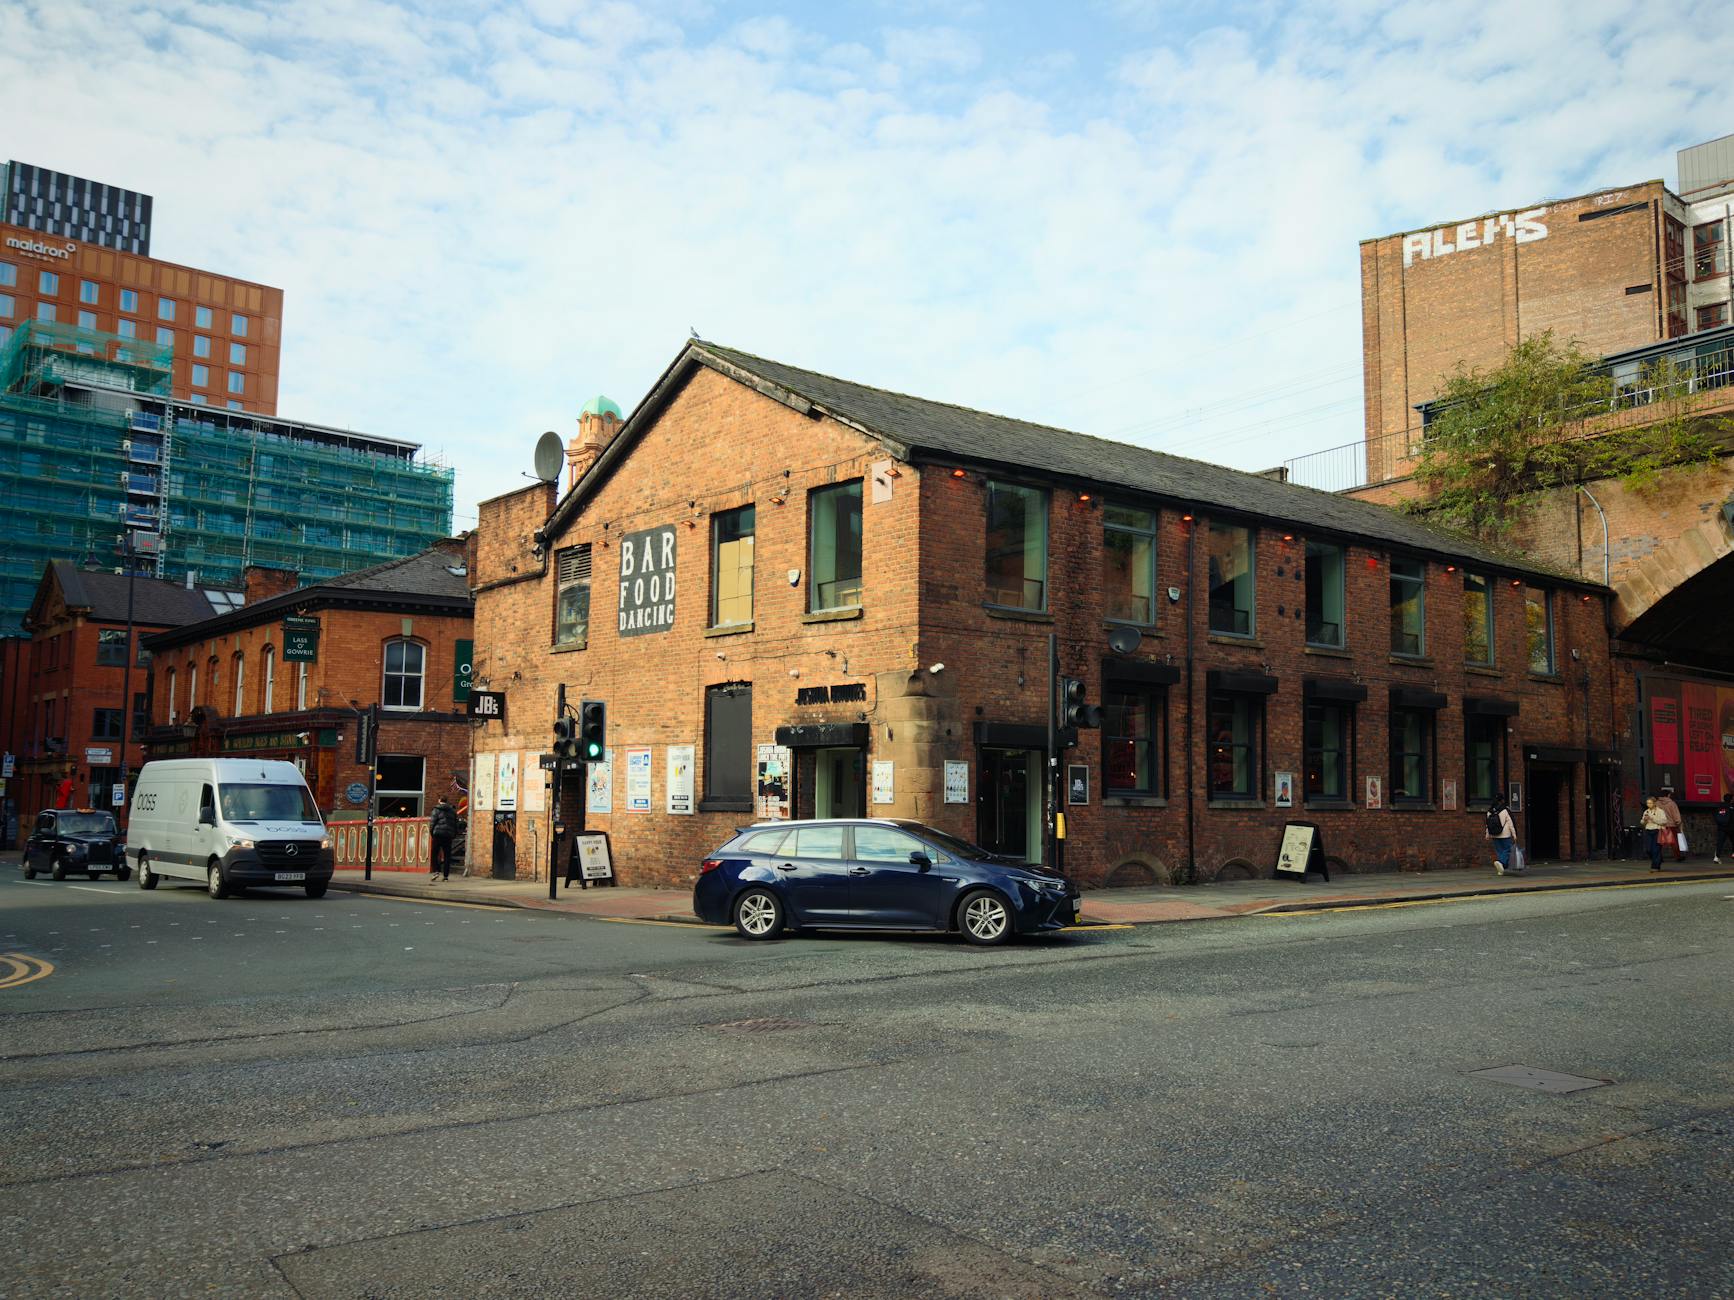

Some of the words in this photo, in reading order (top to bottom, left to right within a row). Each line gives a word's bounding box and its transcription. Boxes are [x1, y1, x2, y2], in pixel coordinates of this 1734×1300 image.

[6, 237, 69, 259] maldron
[621, 532, 675, 576] BAR
[620, 572, 676, 608] FOOD
[619, 604, 675, 631] DANCING
[474, 695, 499, 715] JB's
